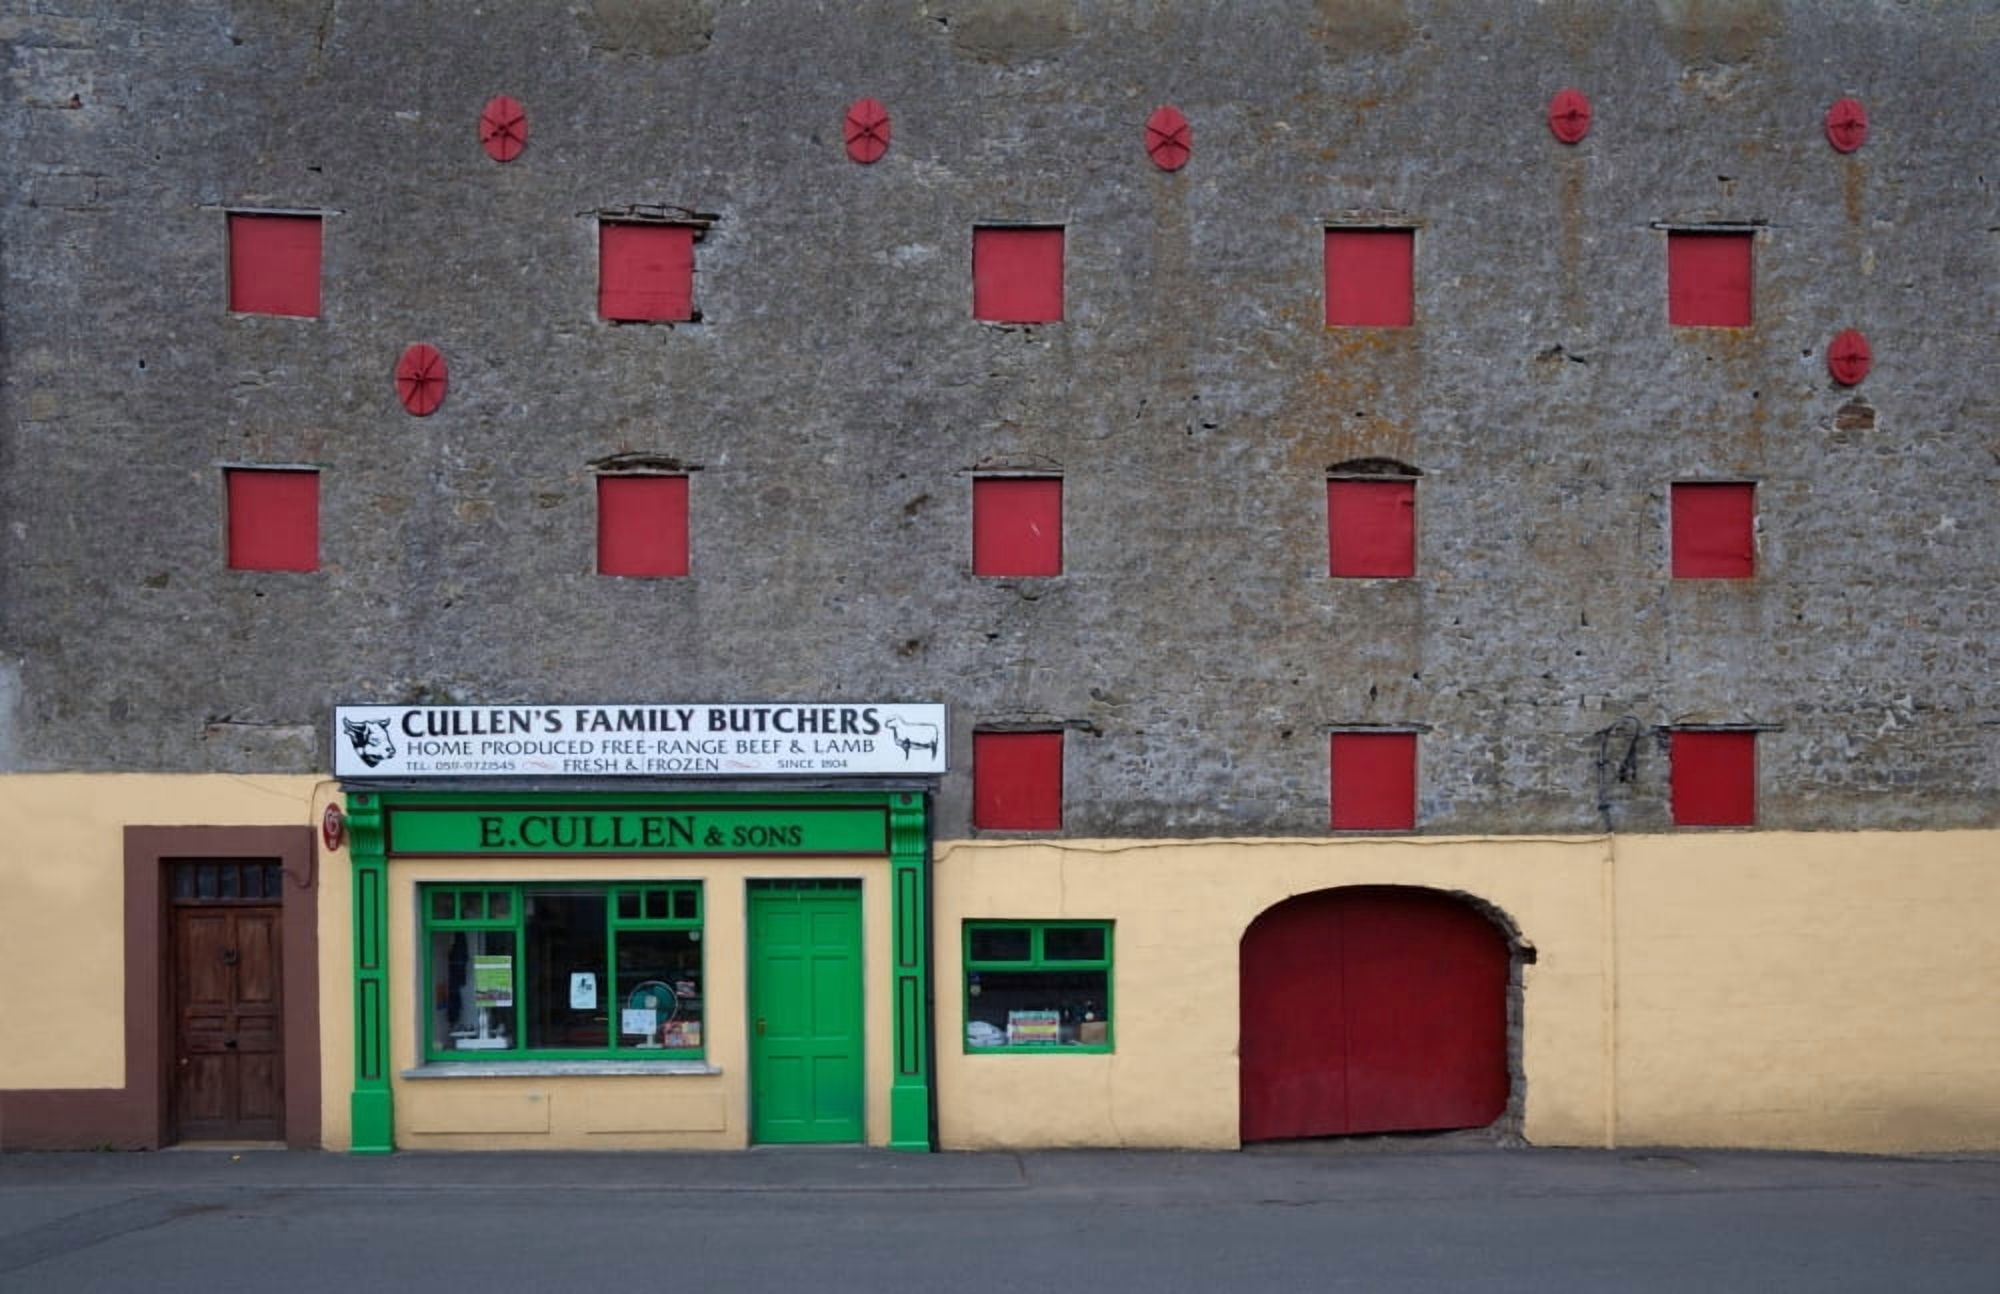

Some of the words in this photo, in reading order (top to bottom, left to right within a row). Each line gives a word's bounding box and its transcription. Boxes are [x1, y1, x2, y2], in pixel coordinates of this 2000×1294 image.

[402, 709, 563, 738] CULLEN'S
[576, 708, 695, 732] FAMILY
[707, 707, 880, 735] BUTCHERS
[407, 741, 473, 756] HOME
[481, 740, 594, 755] PRODUCED
[602, 739, 728, 755] FREE-RANGE
[736, 739, 782, 754] BEEF
[790, 739, 805, 754] &
[814, 739, 875, 753] LAMB
[563, 758, 618, 772] FRESH
[625, 758, 639, 771] &
[647, 757, 719, 772] FROZEN
[777, 759, 814, 769] SINCE
[703, 826, 724, 848] &
[731, 825, 804, 848] SONS
